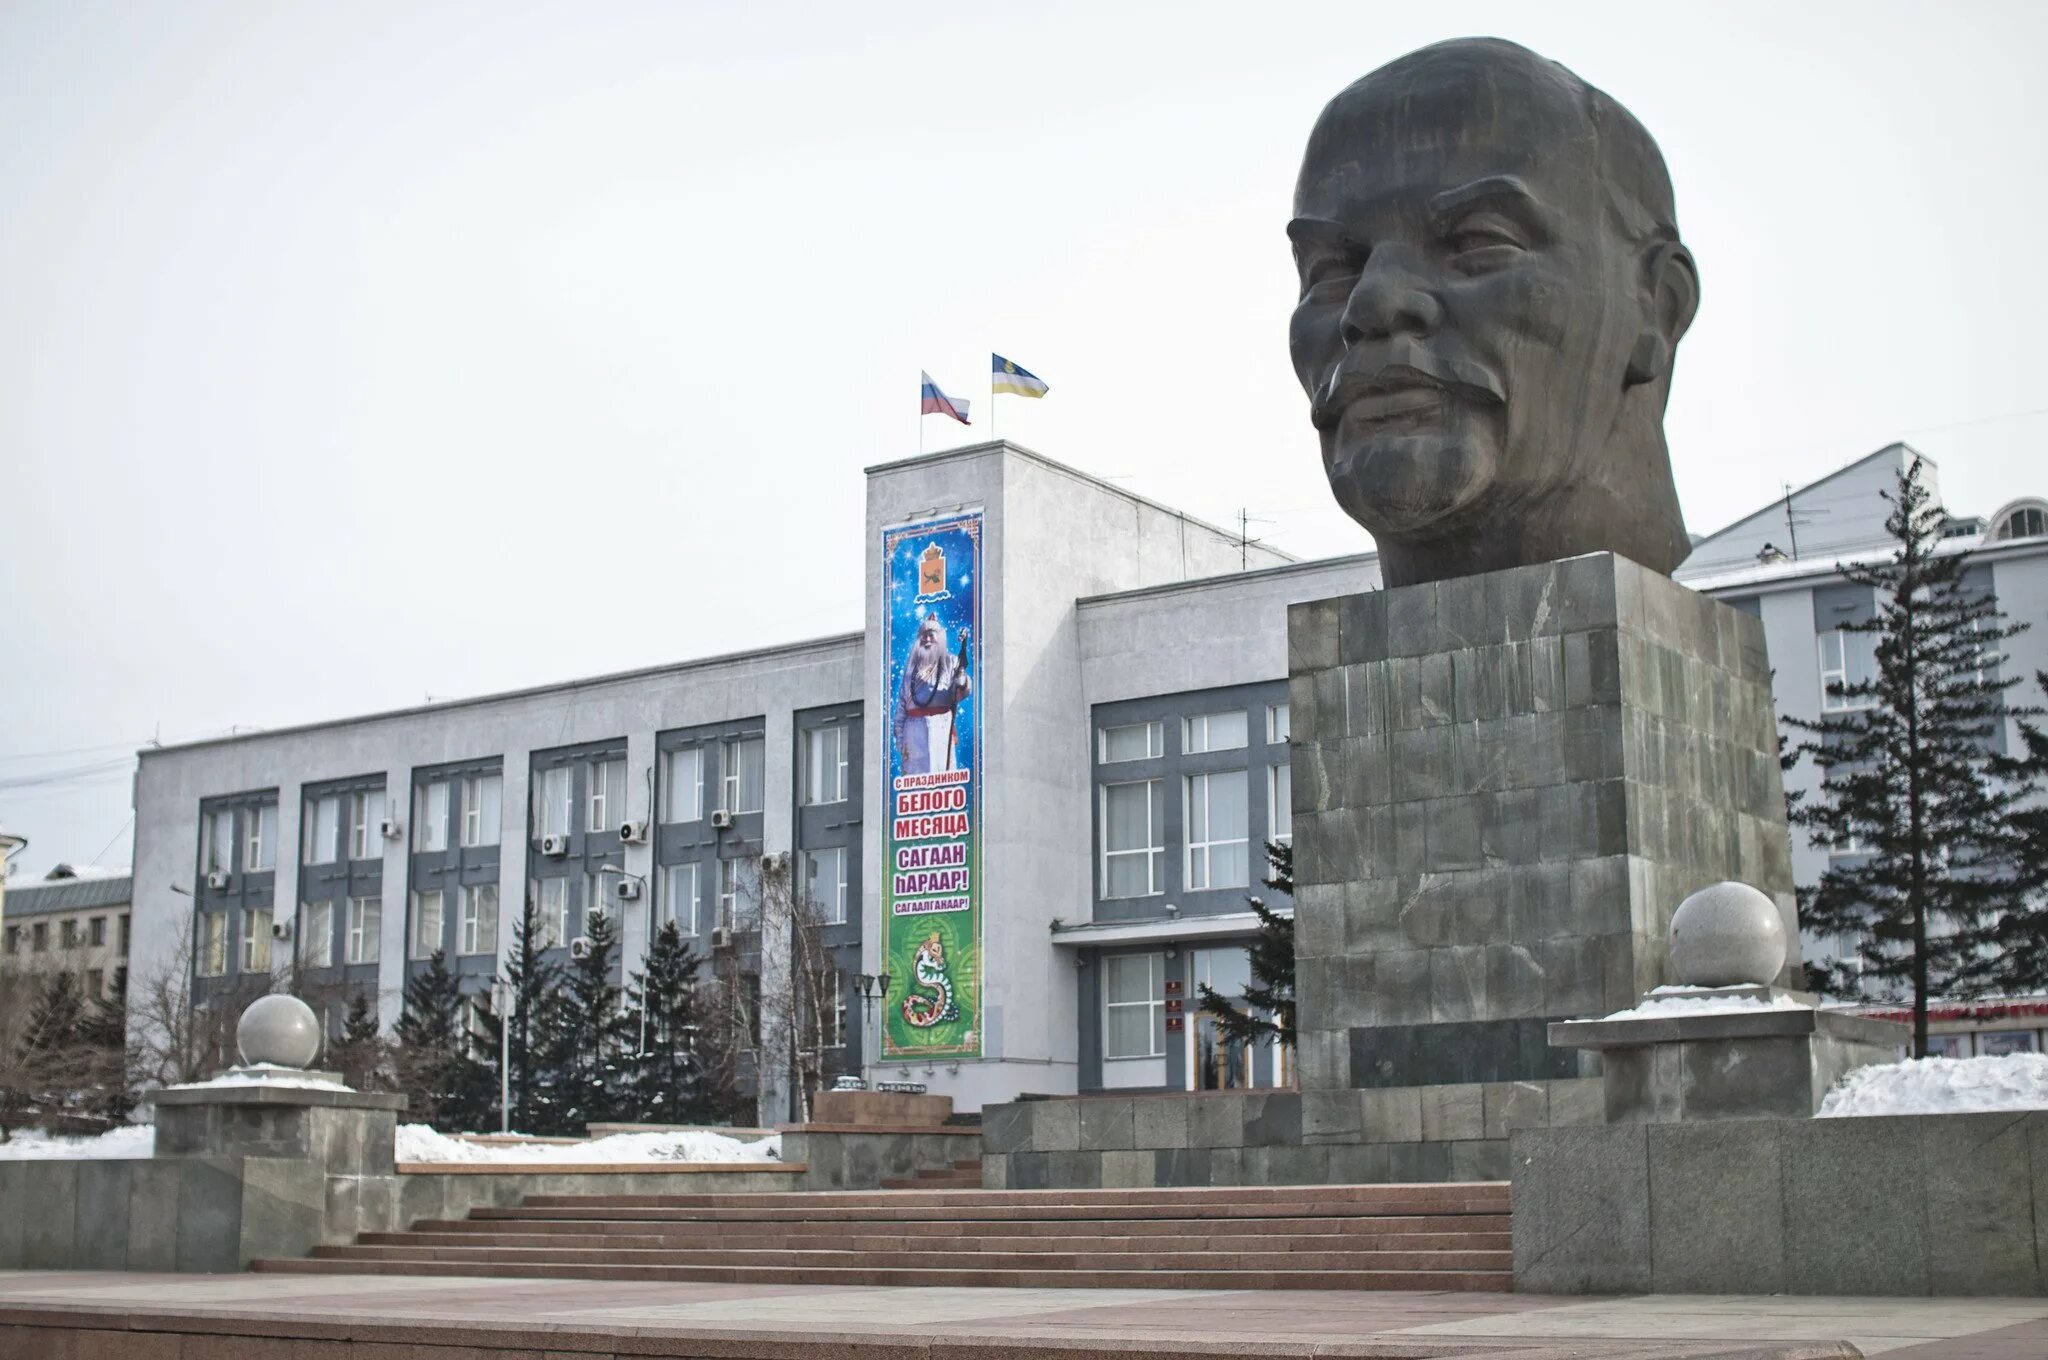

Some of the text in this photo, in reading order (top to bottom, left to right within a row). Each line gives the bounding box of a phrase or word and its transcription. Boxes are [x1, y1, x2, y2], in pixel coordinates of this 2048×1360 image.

[896, 771, 968, 789] С ПРАЗДНИКОМ
[899, 789, 964, 813] БЕЛОГО
[896, 814, 968, 839] МЕСЯЦА
[898, 845, 964, 868] САГААН
[895, 898, 968, 914] САГААЛГАНААР!
